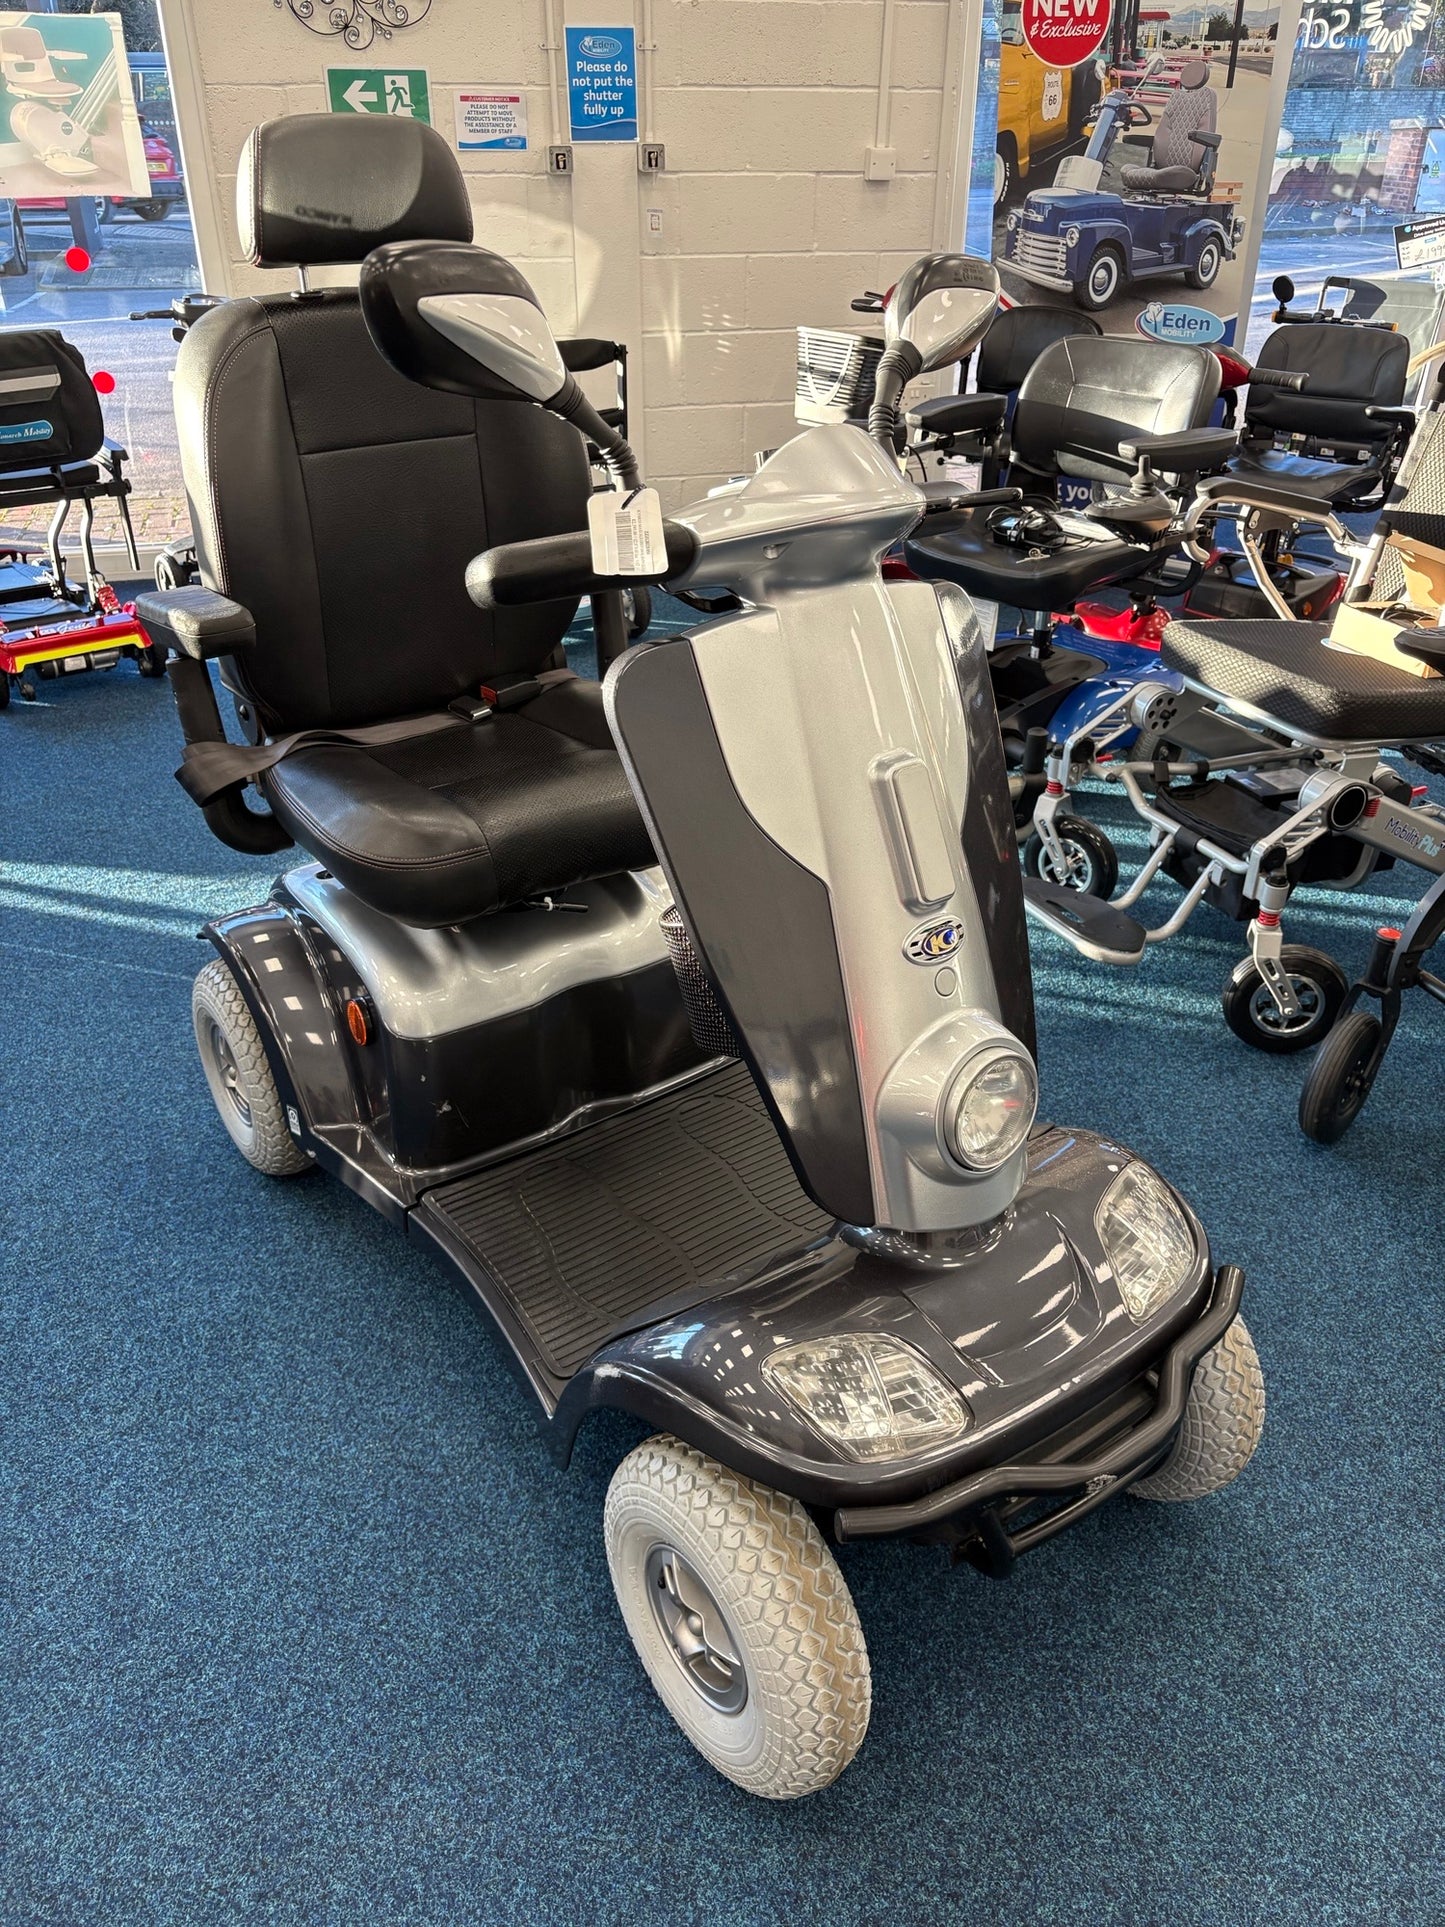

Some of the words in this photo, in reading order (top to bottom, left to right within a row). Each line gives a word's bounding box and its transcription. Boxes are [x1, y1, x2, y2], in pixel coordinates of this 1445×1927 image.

[1032, 0, 1098, 17] NEW
[1040, 17, 1101, 38] Exclusive
[592, 40, 615, 48] Eden
[576, 61, 611, 72] Please
[614, 61, 628, 72] do
[572, 76, 591, 86] not
[594, 76, 612, 89] put
[615, 75, 633, 87] the
[583, 89, 623, 101] shutter
[1048, 94, 1058, 106] 66
[583, 103, 608, 118] fully
[610, 105, 624, 117] up
[1162, 312, 1211, 331] Eden
[1160, 328, 1197, 338] MOBILITY
